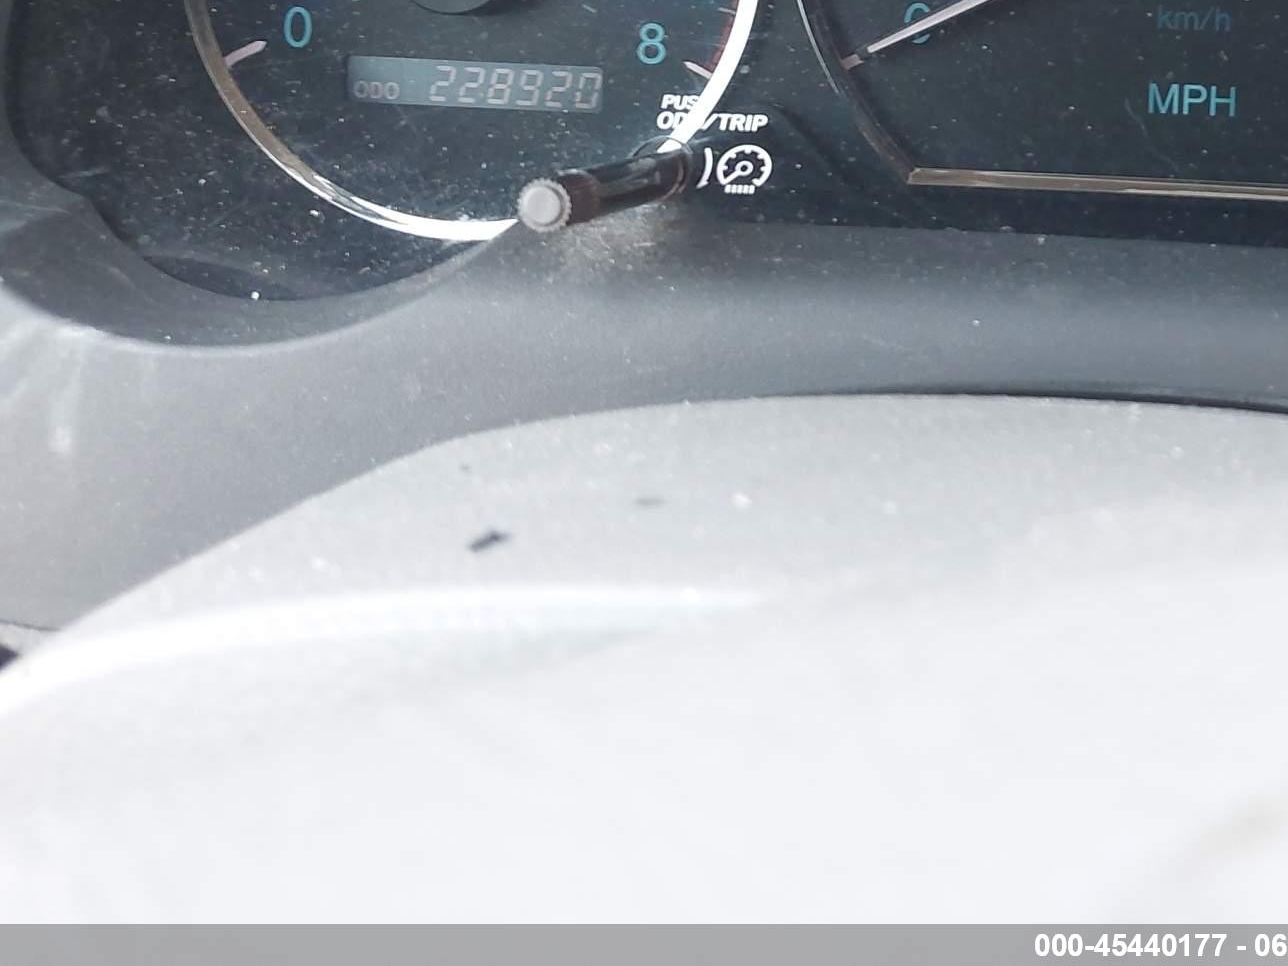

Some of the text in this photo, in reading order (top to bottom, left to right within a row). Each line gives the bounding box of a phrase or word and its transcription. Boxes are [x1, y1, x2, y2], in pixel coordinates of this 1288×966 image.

[283, 6, 313, 48] 0
[1157, 4, 1232, 32] km/h
[636, 23, 668, 65] 8
[428, 65, 602, 109] 228920
[1148, 83, 1237, 117] MPH
